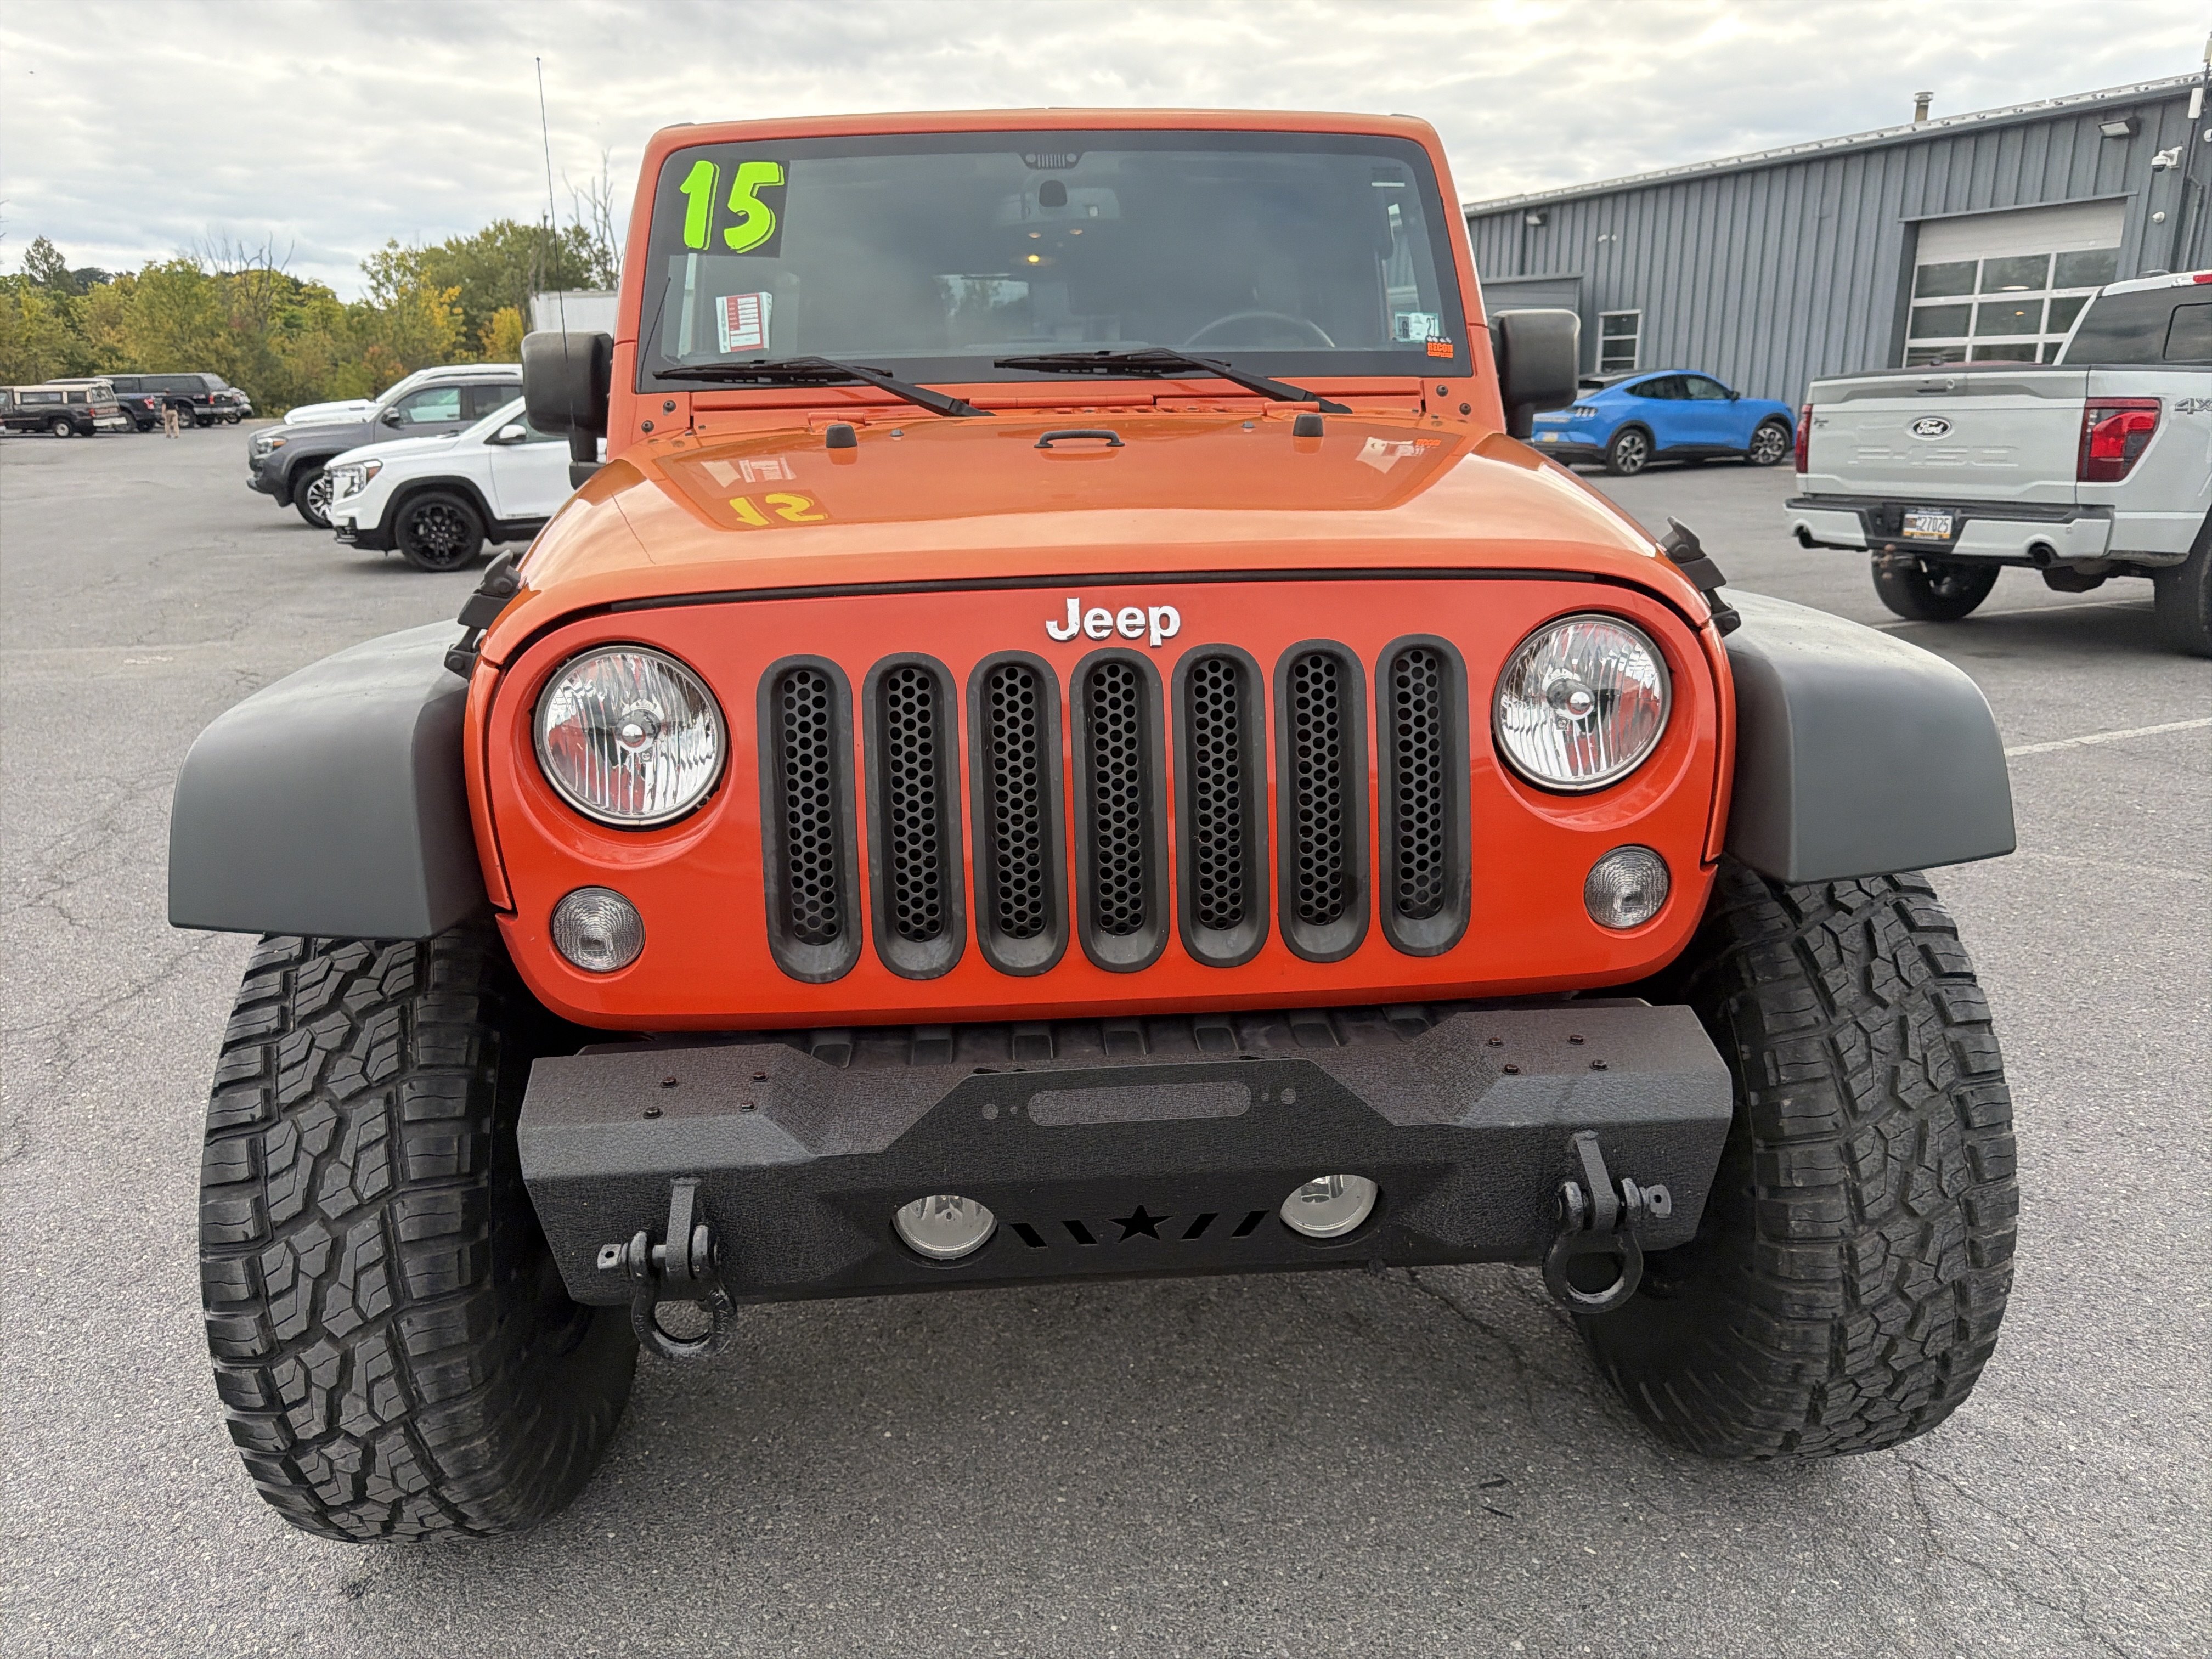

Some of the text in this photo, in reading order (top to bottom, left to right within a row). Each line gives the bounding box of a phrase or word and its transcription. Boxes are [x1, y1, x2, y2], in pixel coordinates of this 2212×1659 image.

[680, 160, 784, 253] 15
[1916, 420, 1945, 434] Ford
[1046, 597, 1181, 648] Jeep
